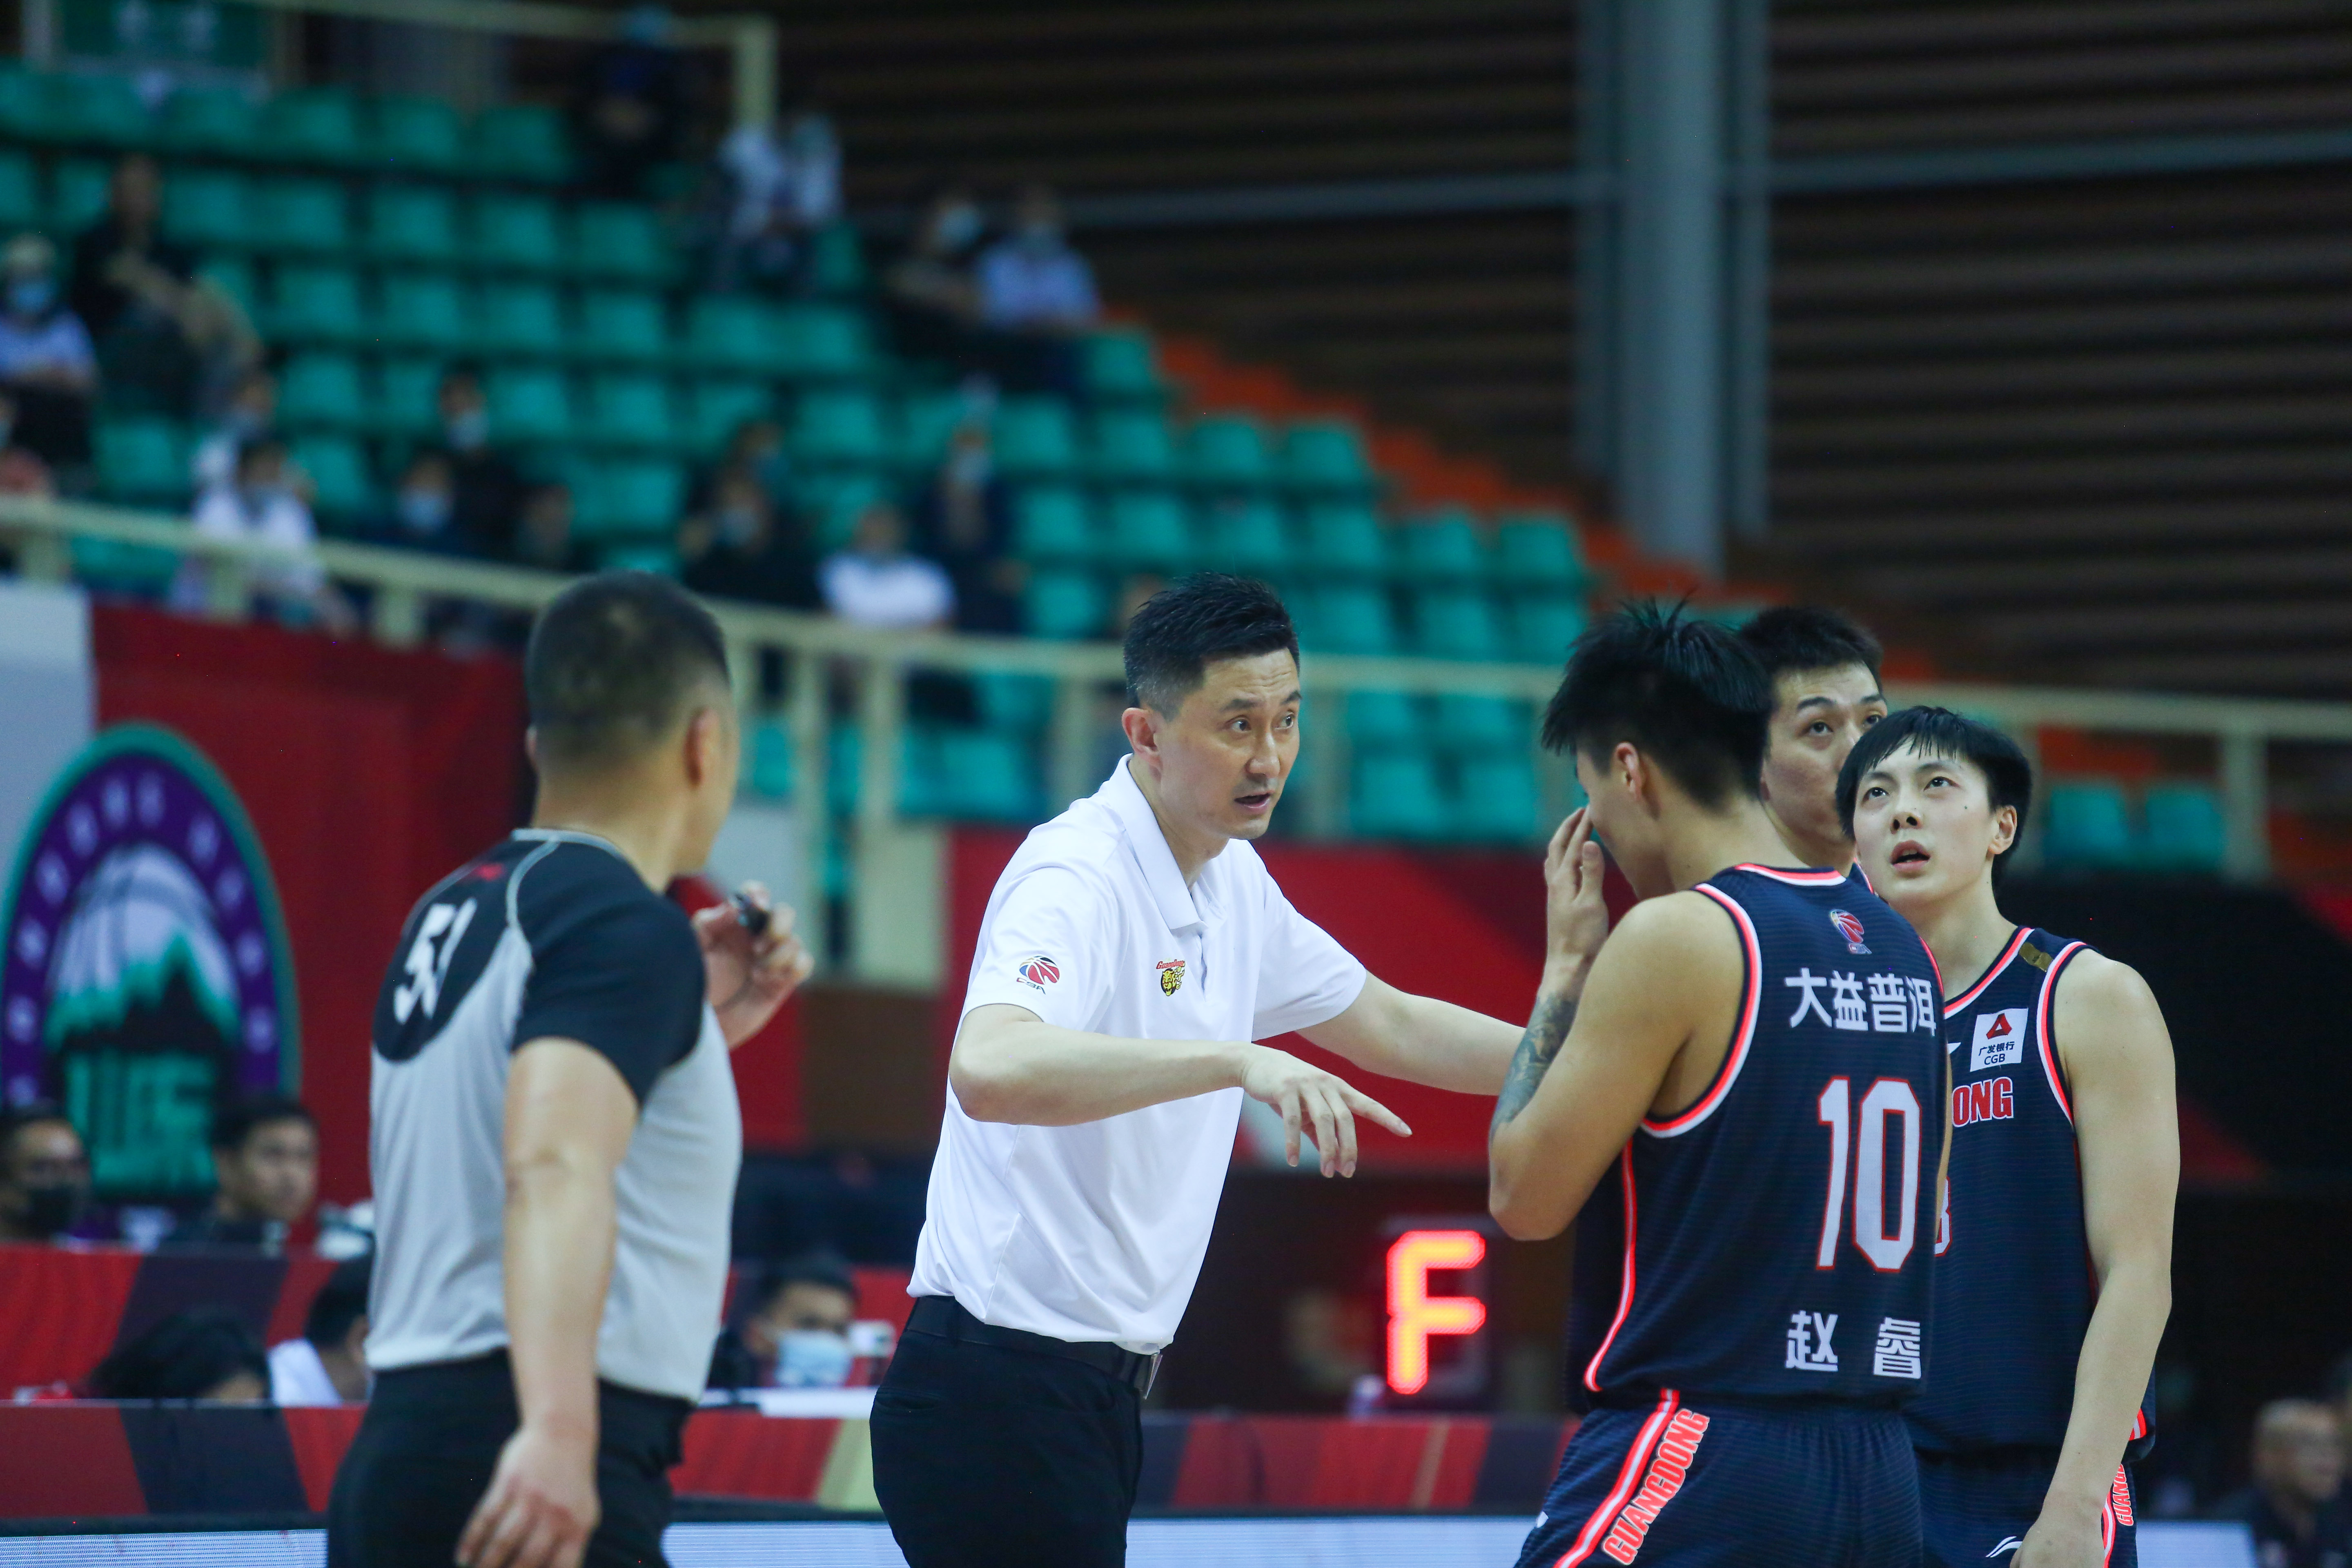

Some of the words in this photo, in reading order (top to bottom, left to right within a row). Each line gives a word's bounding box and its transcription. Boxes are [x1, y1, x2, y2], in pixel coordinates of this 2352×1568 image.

[1016, 977, 1046, 995] CBA
[1785, 967, 1936, 1037] 大益普洱
[1978, 1041, 2015, 1056] 广发银行
[1984, 1054, 2005, 1065] CGB
[1816, 1076, 1922, 1272] 10
[1386, 1230, 1486, 1395] F
[1602, 1408, 1710, 1566] GUANGDONG
